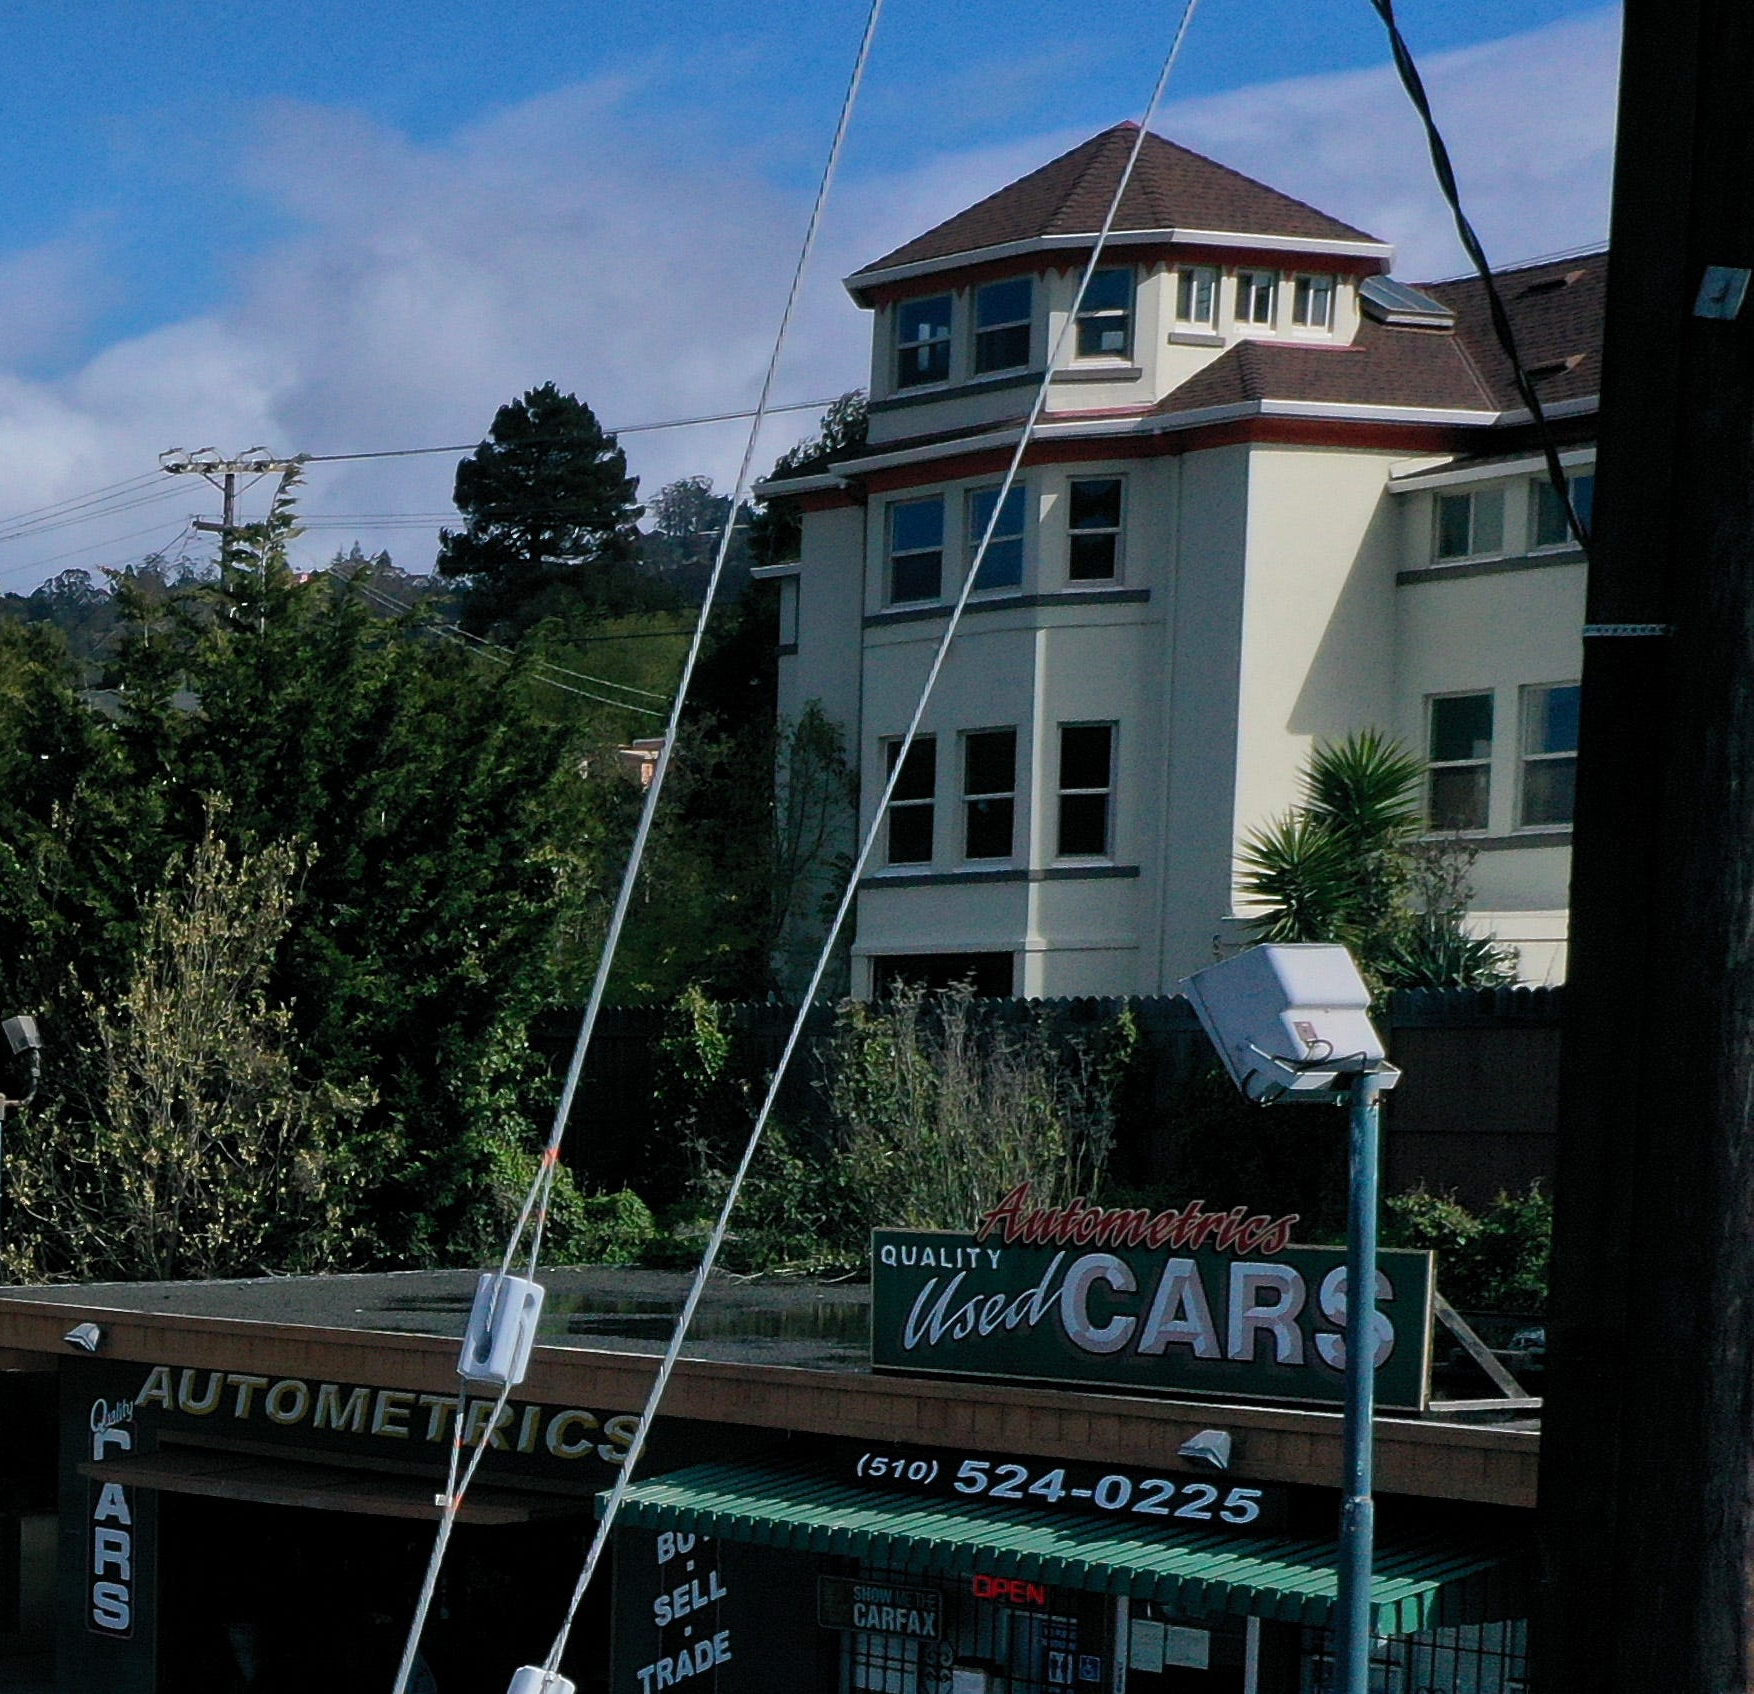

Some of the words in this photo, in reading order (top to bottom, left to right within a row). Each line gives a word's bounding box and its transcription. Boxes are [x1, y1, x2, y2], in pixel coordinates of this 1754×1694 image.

[978, 1180, 1300, 1255] Autometrics
[881, 1244, 1002, 1270] QUALITY
[902, 1249, 1067, 1351] Used
[1060, 1252, 1395, 1373] CARS
[90, 1397, 134, 1434] Quality
[134, 1366, 648, 1465] AUTOMETRICS
[856, 1452, 939, 1485] (510)
[953, 1459, 1264, 1525] 524-0225
[657, 1531, 711, 1565] BU
[653, 1570, 727, 1627] SELL
[973, 1574, 1046, 1606] OPEN
[852, 1601, 938, 1637] CARFAX
